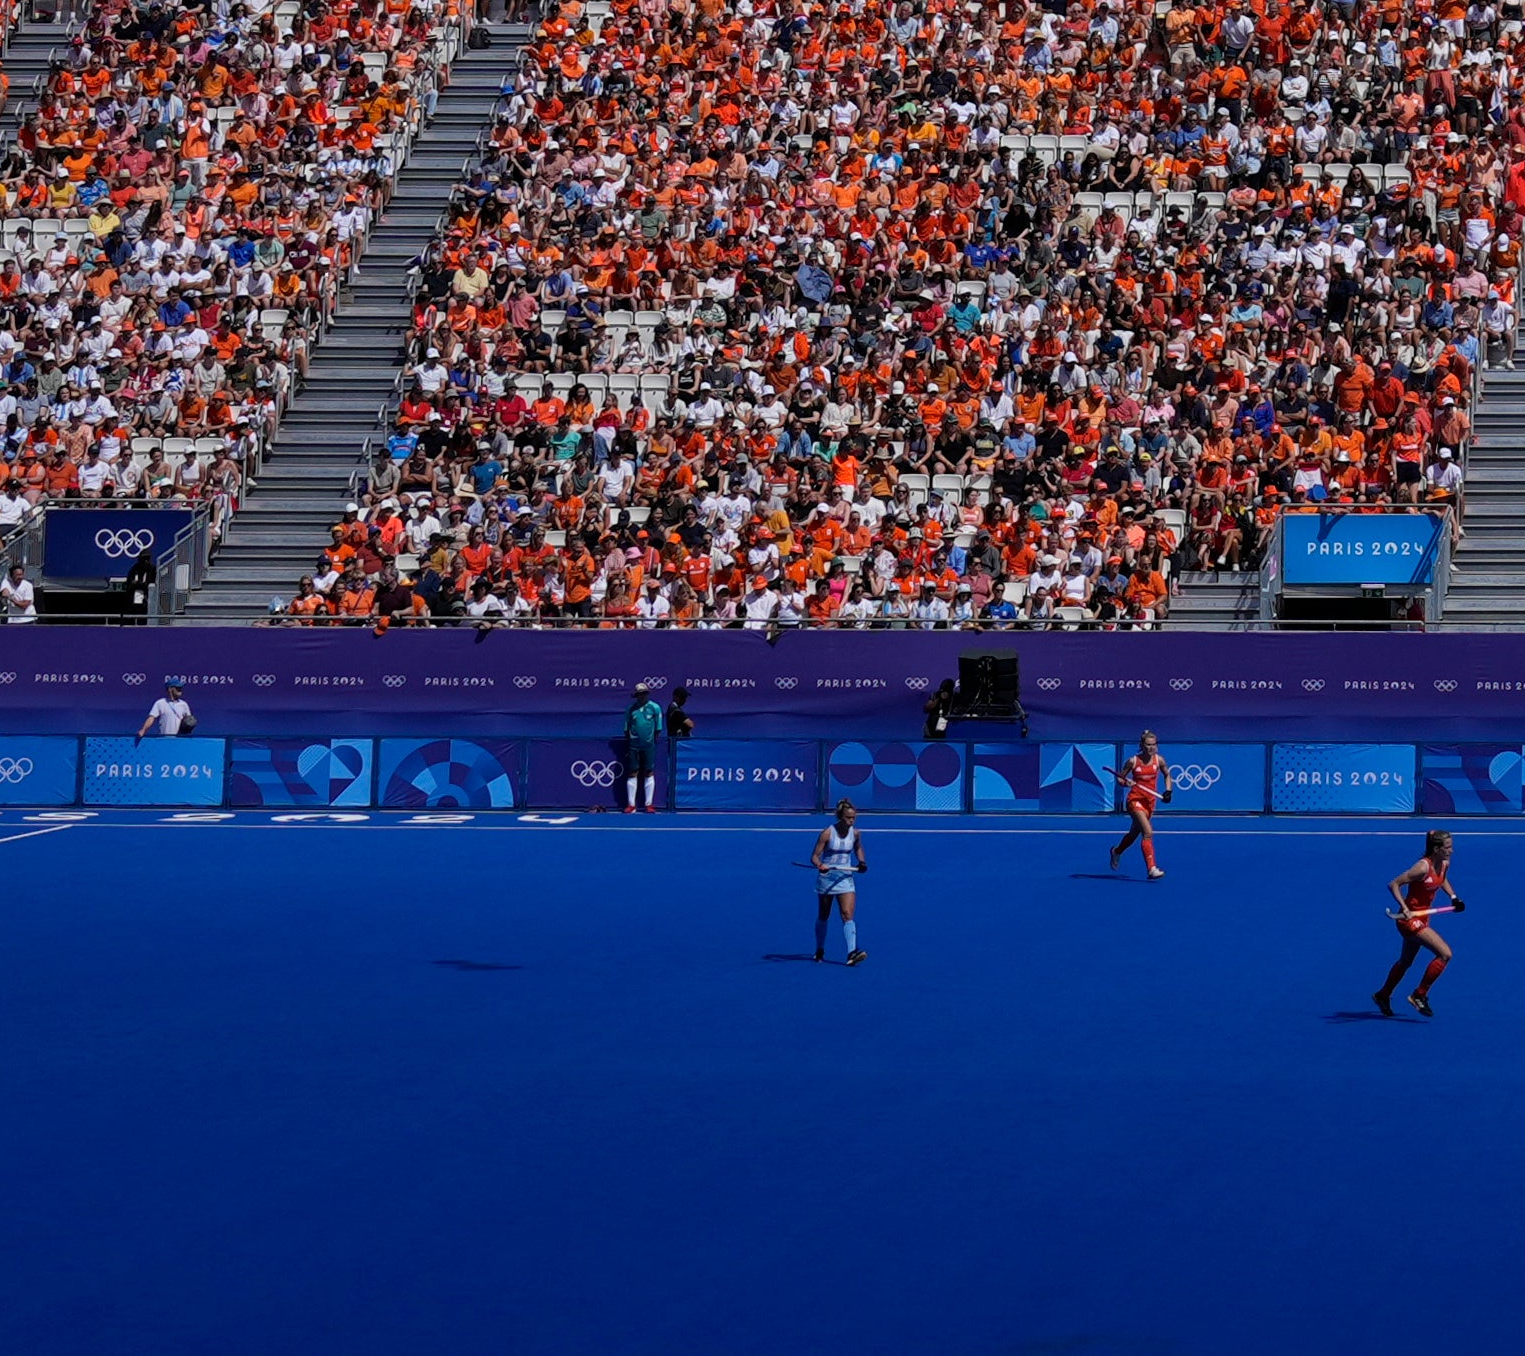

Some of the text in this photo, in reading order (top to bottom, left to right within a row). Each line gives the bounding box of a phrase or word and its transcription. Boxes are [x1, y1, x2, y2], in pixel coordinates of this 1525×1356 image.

[1308, 542, 1425, 555] PARIS 2024
[35, 674, 103, 682] PARIS 2024
[203, 676, 234, 684] 2024
[295, 677, 363, 685] PARIS 2024
[425, 678, 494, 686] PARIS 2024
[555, 678, 624, 687] PARIS 2024
[686, 679, 755, 687] PARIS 2024
[817, 679, 886, 688] PARIS 2024
[1080, 680, 1150, 688] PARIS 2024
[1212, 681, 1282, 689] PARIS 2024
[1345, 681, 1414, 689] PARIS 2024
[1477, 682, 1511, 690] PARIS
[96, 764, 211, 778] PARIS 2024
[688, 768, 804, 782] PARIS 2024
[1285, 771, 1402, 785] PARIS 2024
